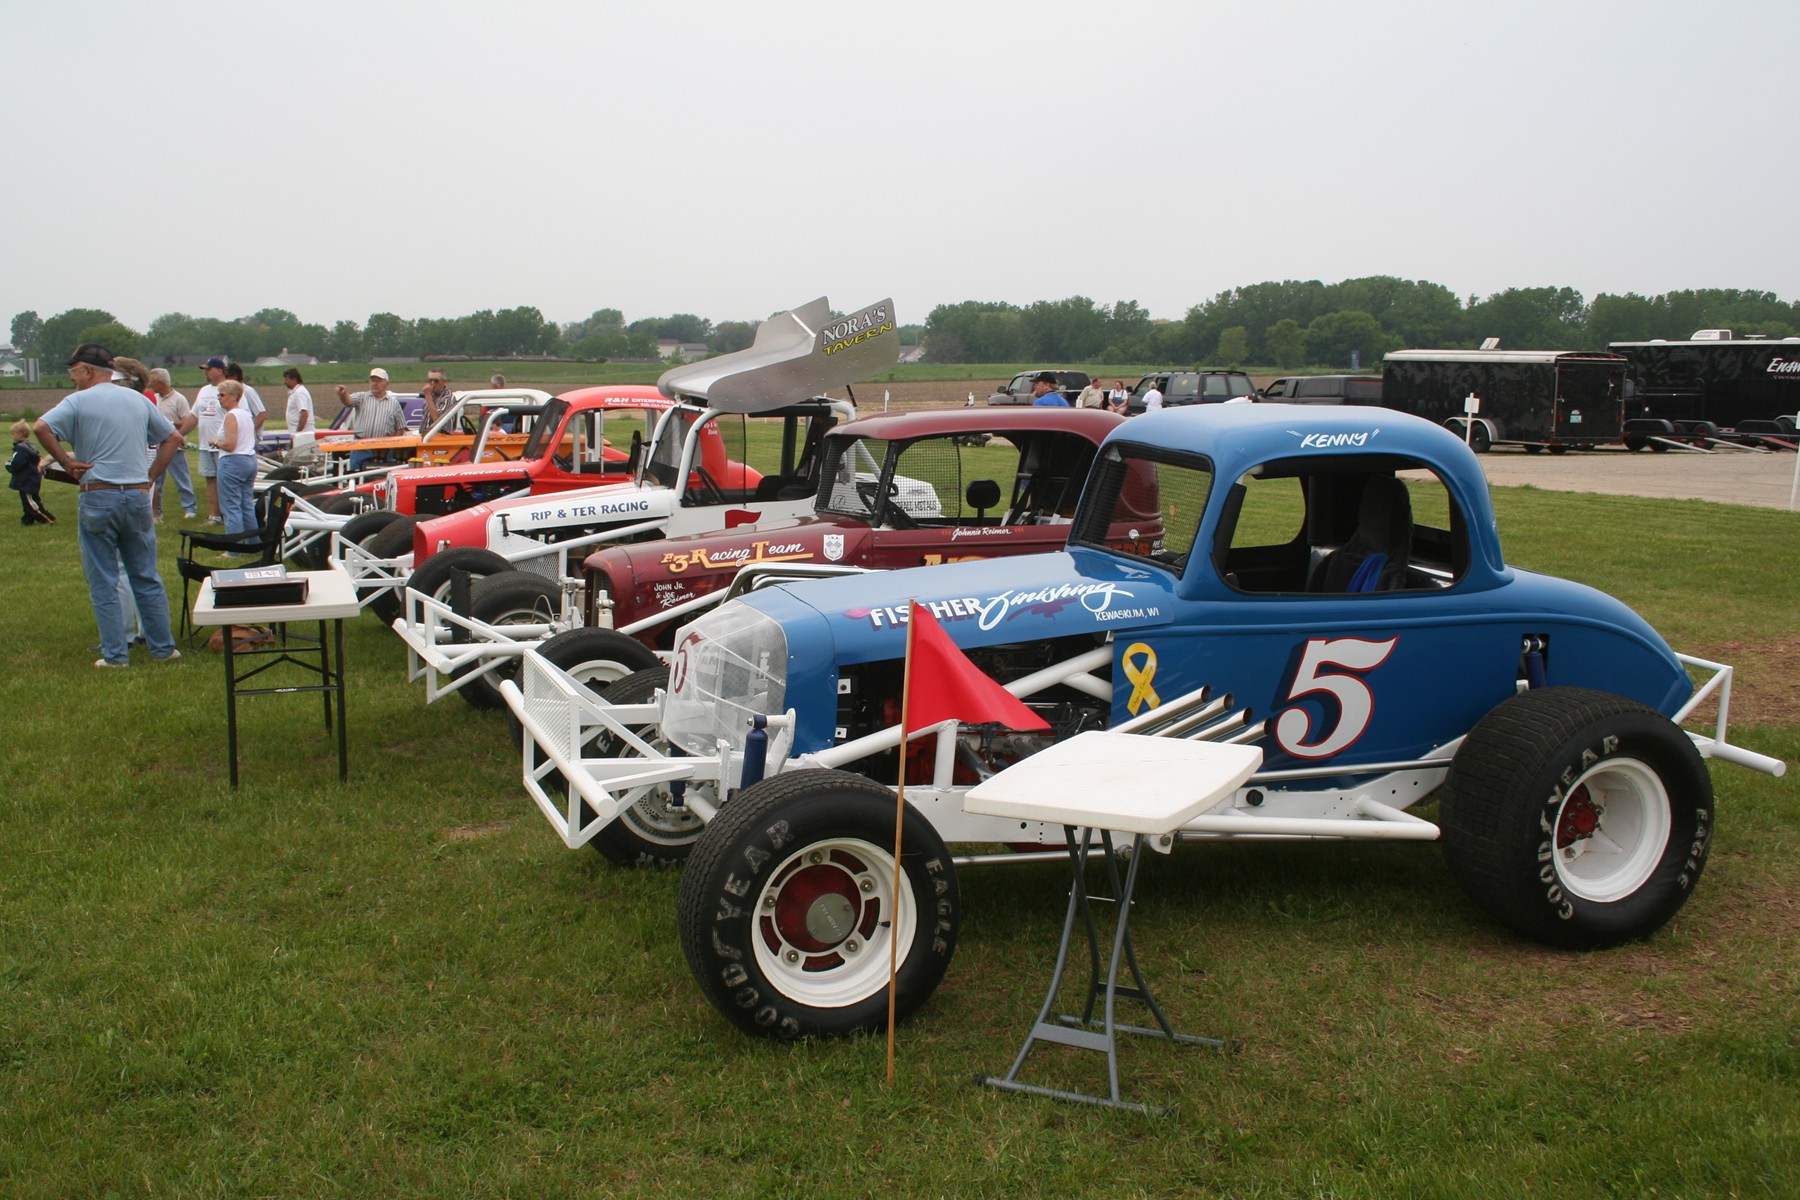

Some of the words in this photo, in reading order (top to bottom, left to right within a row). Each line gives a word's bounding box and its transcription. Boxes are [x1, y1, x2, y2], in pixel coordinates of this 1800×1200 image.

[822, 306, 886, 345] NORA'S
[823, 321, 893, 356] TAVERN
[400, 472, 457, 480] Marshall
[460, 468, 503, 476] Metals
[530, 510, 552, 521] RIP
[557, 509, 567, 518] &
[572, 506, 596, 517] TER
[600, 500, 649, 515] RACING
[689, 548, 751, 567] Racing
[752, 541, 805, 563] Team
[654, 583, 672, 591] JOHN
[870, 598, 983, 626] FISHER
[1095, 608, 1147, 621] KEWASKUM,
[1147, 607, 1160, 617] WI
[1274, 634, 1400, 760] 5
[1537, 734, 1620, 920] GOODYEAR
[1676, 808, 1708, 889] EAGLE
[711, 819, 798, 1039] GOODYEAR
[925, 857, 952, 957] EAGLE
